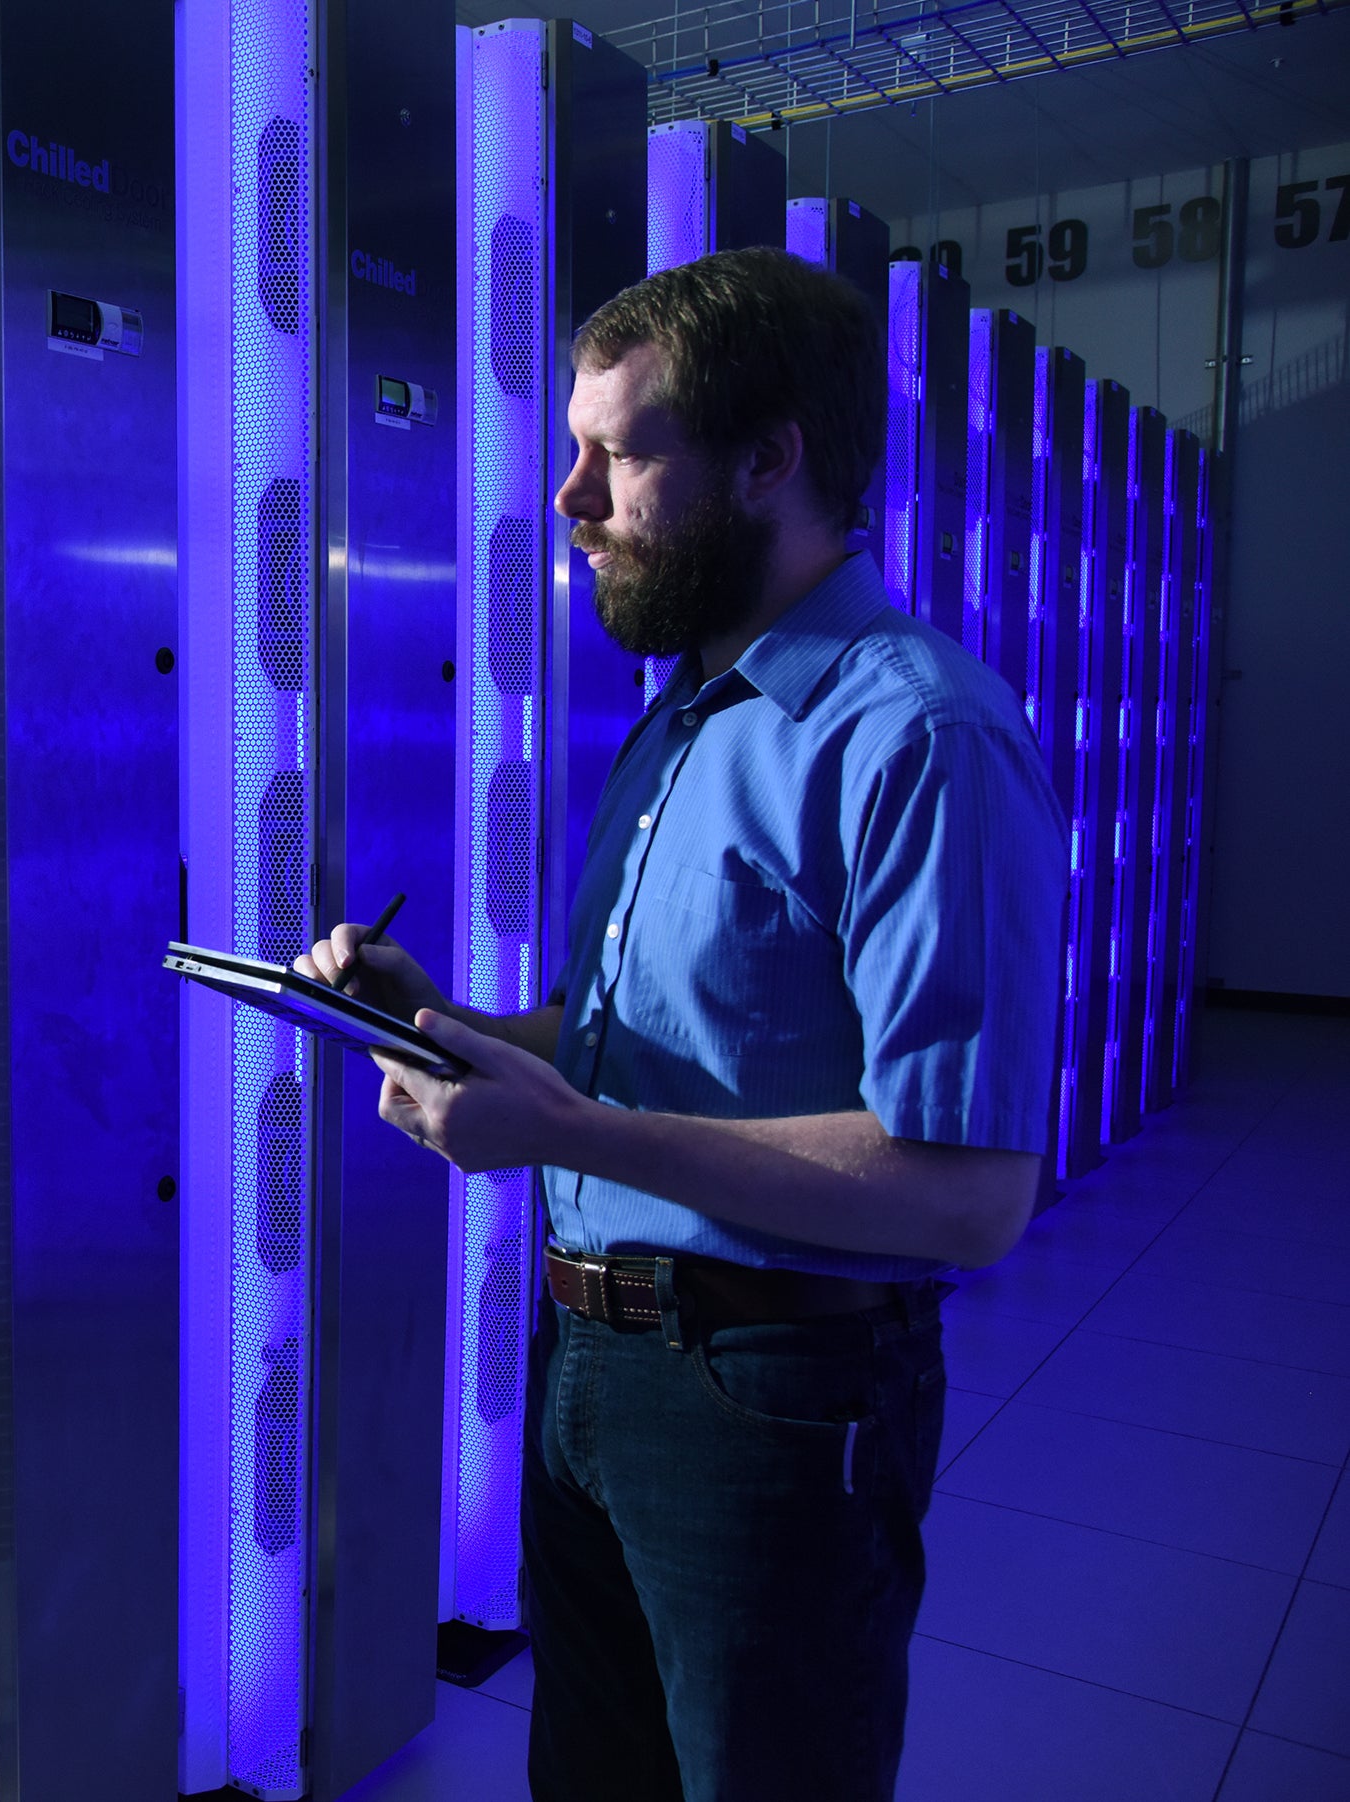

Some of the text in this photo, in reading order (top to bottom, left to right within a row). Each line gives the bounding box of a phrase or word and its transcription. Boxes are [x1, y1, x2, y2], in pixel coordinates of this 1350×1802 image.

[7, 129, 110, 193] Chilled
[1132, 196, 1221, 269] 58
[1275, 175, 1350, 249] 57
[351, 249, 416, 296] Chilled
[1005, 219, 1088, 287] 59
